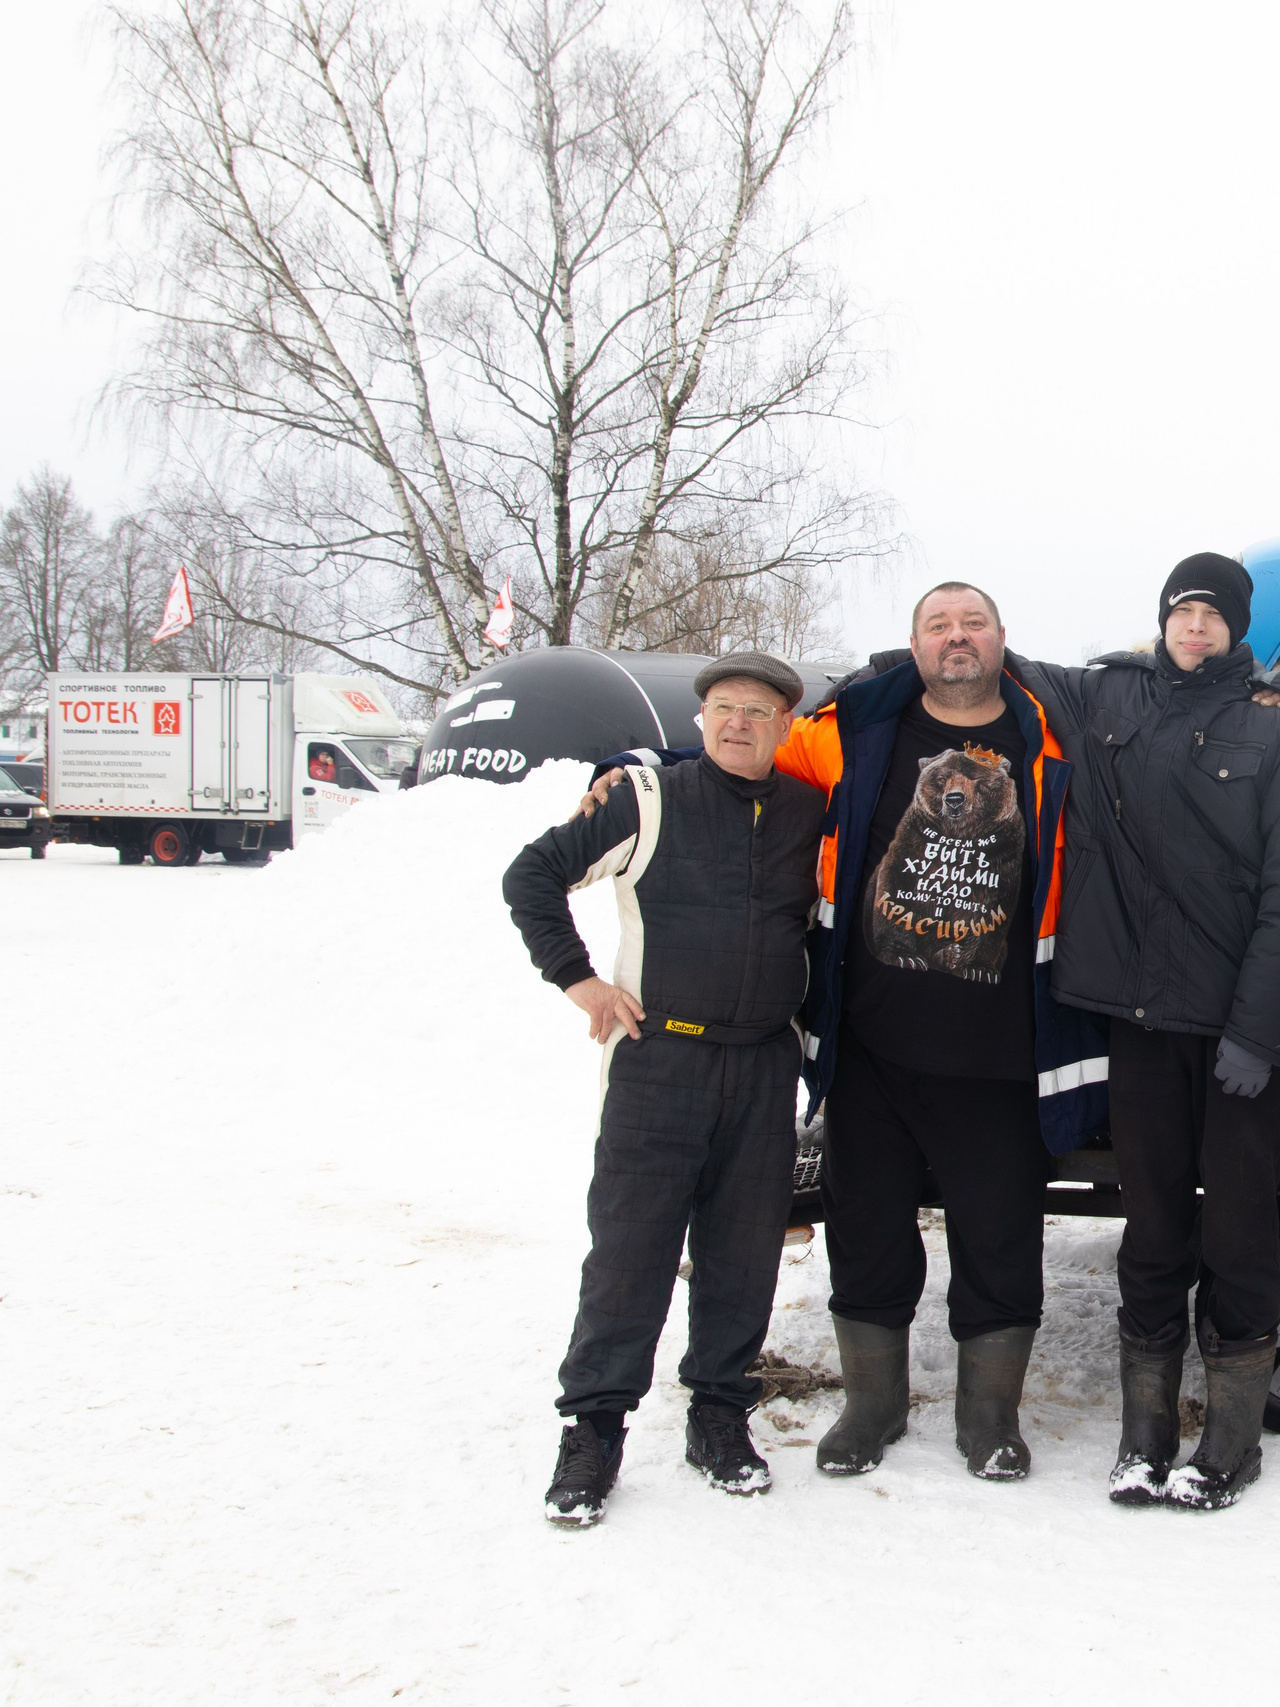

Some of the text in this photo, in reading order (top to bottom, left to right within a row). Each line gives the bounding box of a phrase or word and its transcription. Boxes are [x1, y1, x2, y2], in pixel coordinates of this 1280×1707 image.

[59, 685, 166, 693] СПОРТИВНОЕ ТОПЛИВО
[58, 701, 139, 724] ТОТЕК
[421, 747, 527, 776] MEAT FOOD
[922, 827, 997, 848] НЕ ВСЕМ ЖЕ
[924, 842, 990, 868] БЫТЬ
[902, 857, 1000, 889] ХУДЫМИ
[916, 878, 972, 900] НАДО
[896, 889, 988, 914] КОМУ-ТО БЫТЬ
[935, 906, 943, 917] И
[875, 890, 1007, 942] КРАСИВЫМ
[670, 1021, 701, 1034] Sabelt
